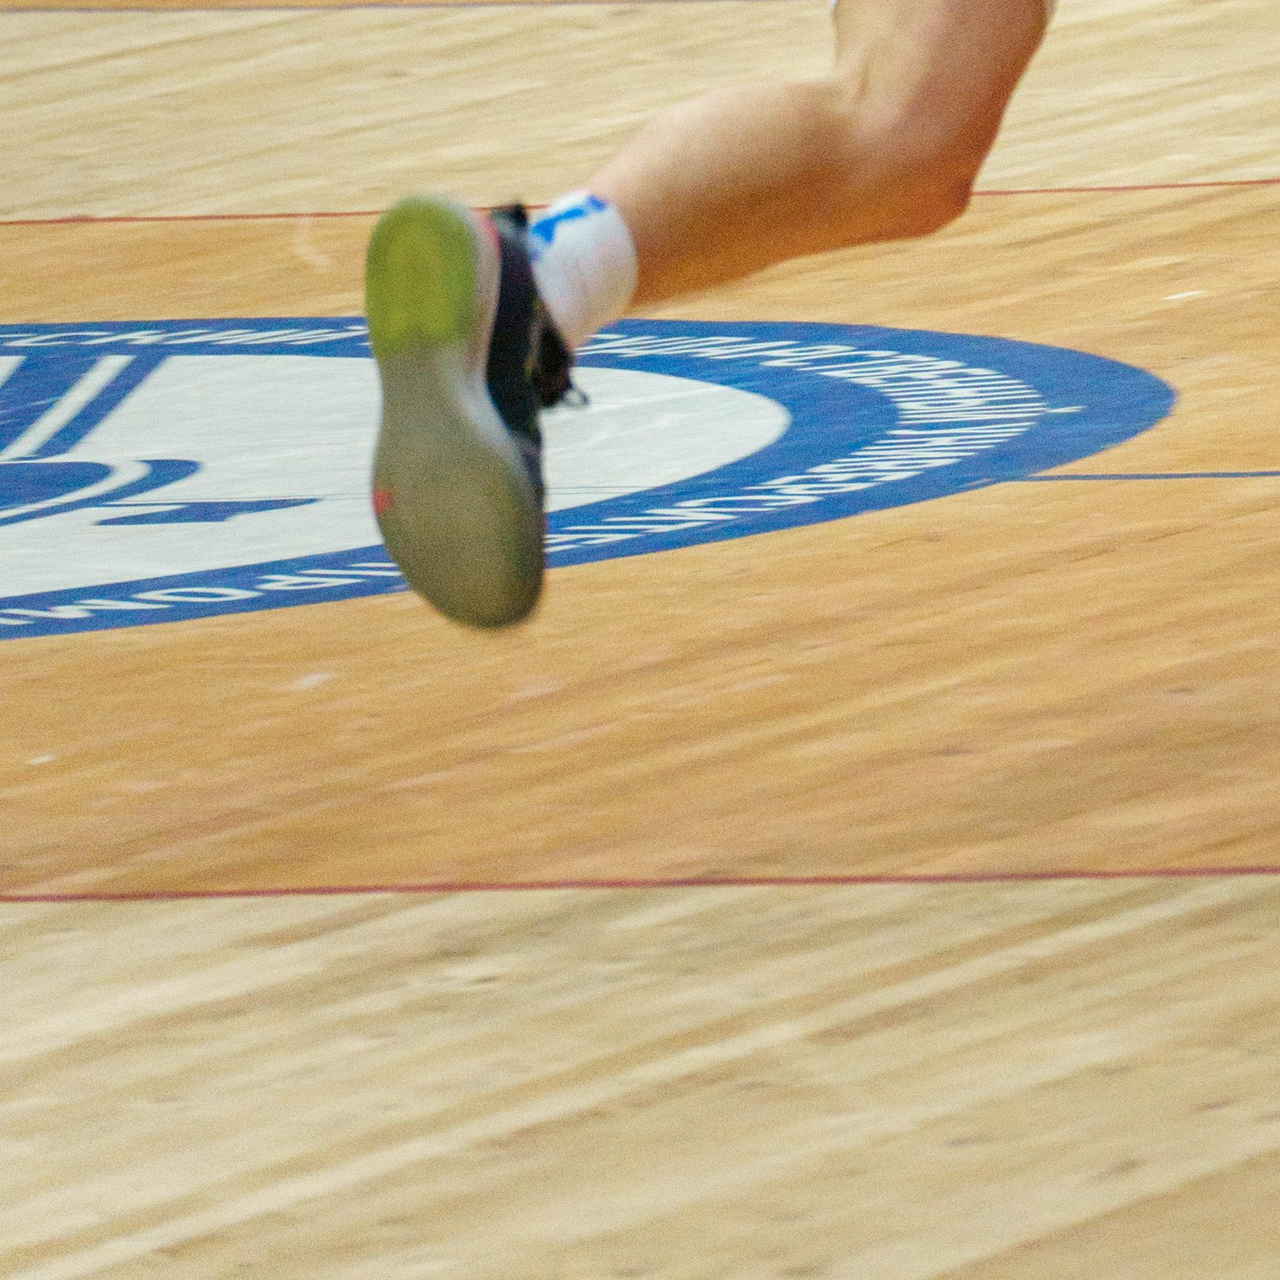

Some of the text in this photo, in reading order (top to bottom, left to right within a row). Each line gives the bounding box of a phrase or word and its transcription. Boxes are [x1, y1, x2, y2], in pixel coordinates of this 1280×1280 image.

[572, 332, 1087, 425] УДАРСТВЕННЫЙ
[543, 422, 1037, 552] УНИВЕРСИТЕ
[0, 562, 403, 626] ПРОМ
